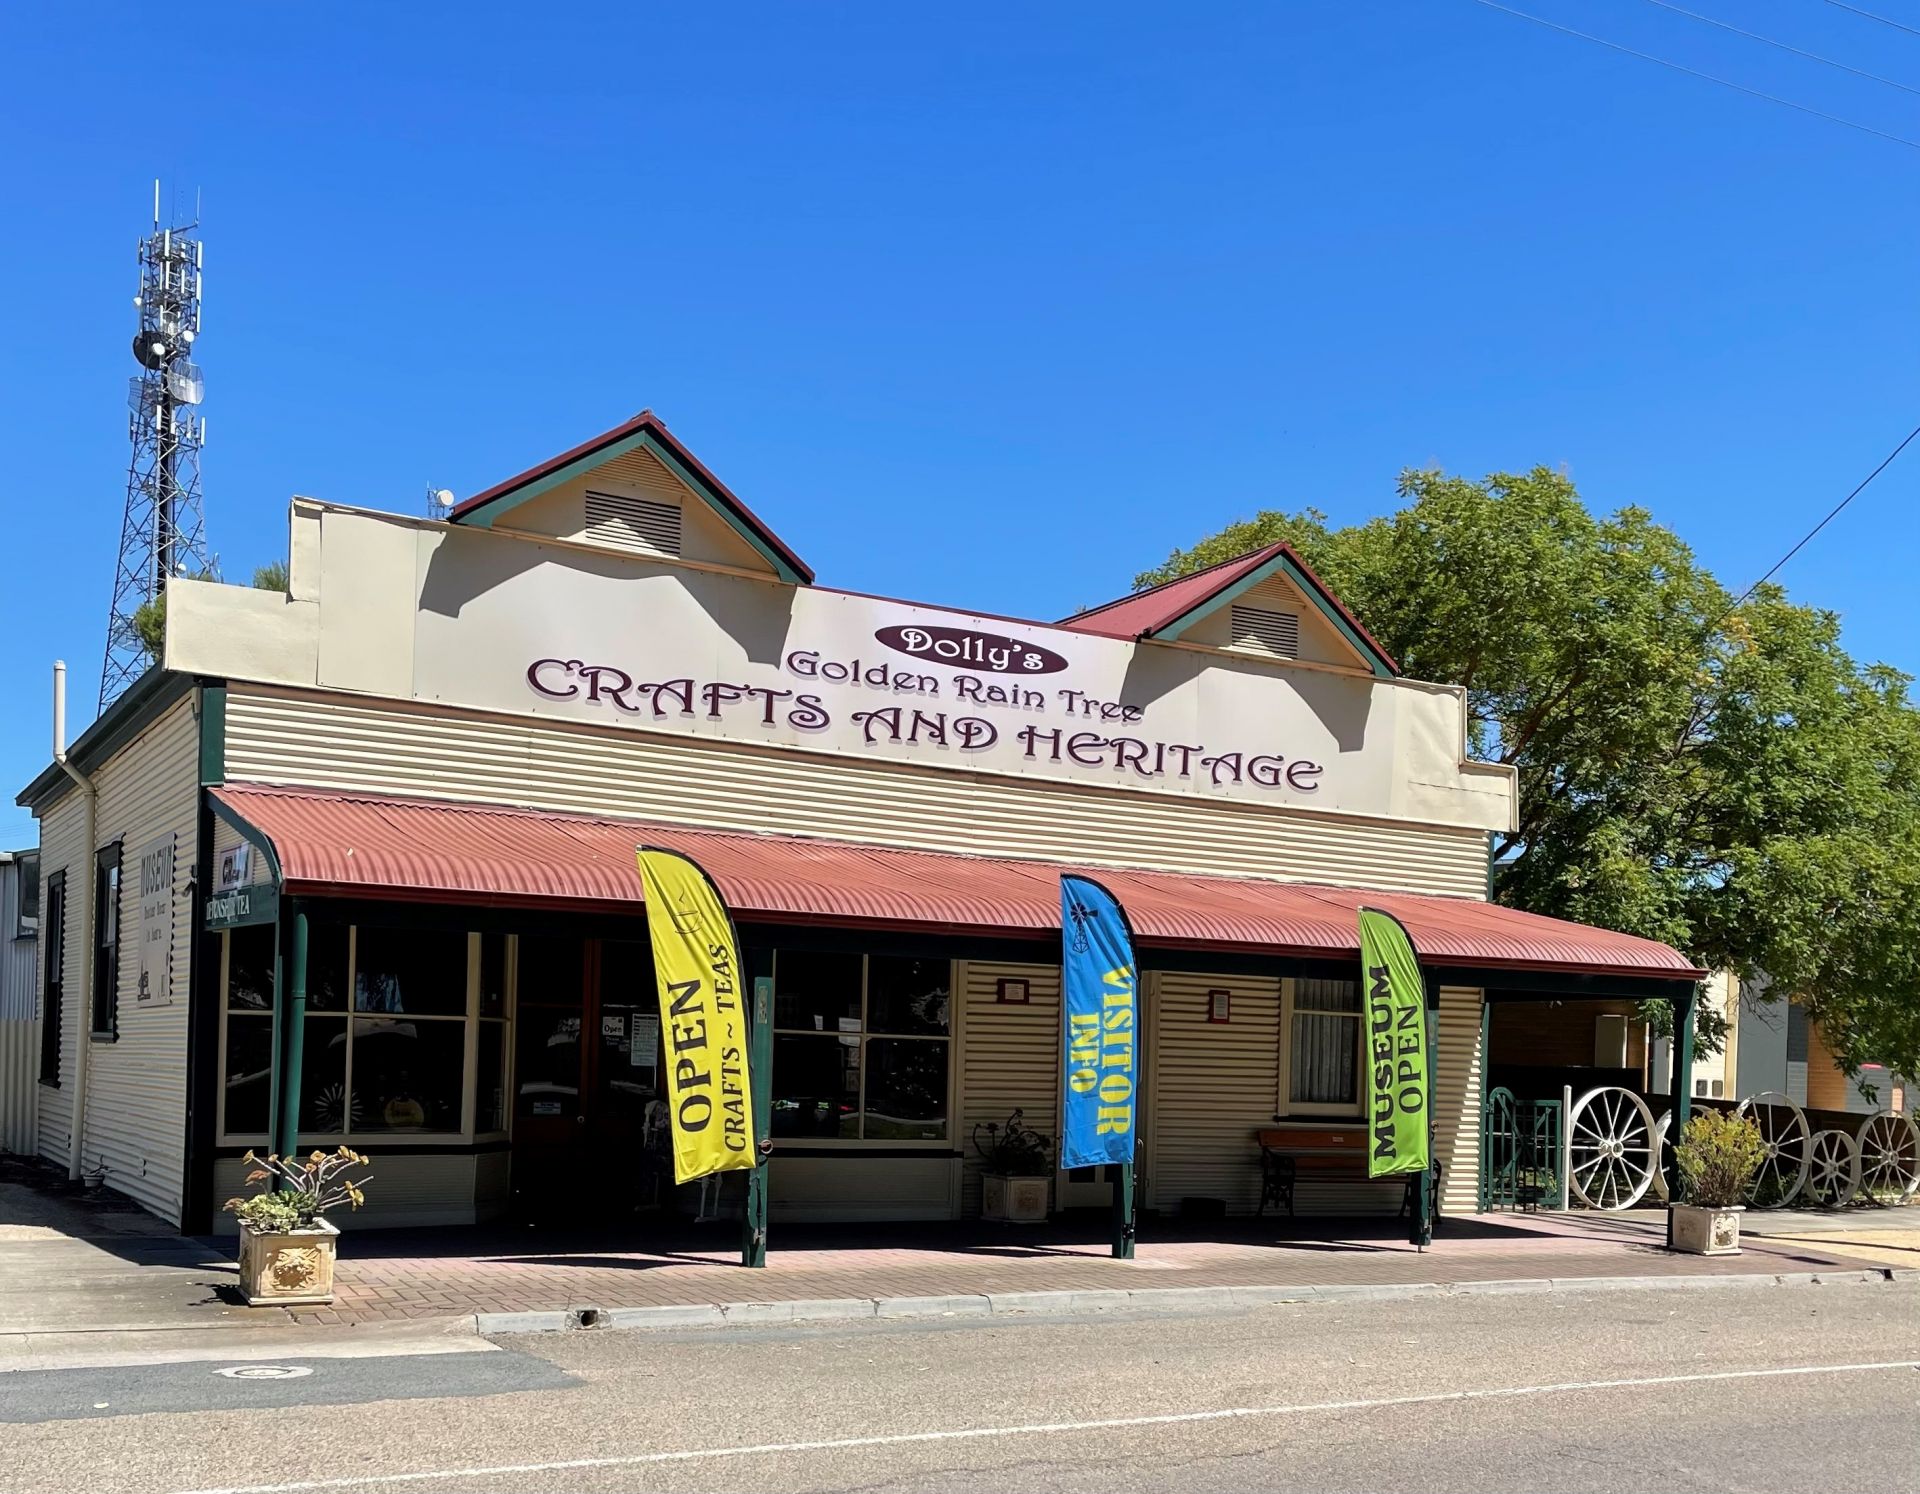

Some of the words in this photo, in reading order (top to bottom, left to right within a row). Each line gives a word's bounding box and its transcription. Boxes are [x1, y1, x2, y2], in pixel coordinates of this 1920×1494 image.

[788, 650, 940, 695] Golden
[954, 675, 1046, 709] Rain
[1058, 689, 1143, 724] Tree
[900, 627, 1045, 673] Dolly's
[527, 658, 831, 730] CRAFTS
[850, 707, 999, 750] AND
[1016, 724, 1326, 793] HERITAGE
[140, 844, 173, 898] MUSEUM
[237, 895, 250, 915] TEA
[708, 943, 735, 1014] TEAS
[666, 979, 712, 1133] OPEN
[1070, 1012, 1100, 1093] INFO
[1096, 964, 1133, 1135] VISITOR
[1369, 963, 1397, 1162] MUSEUM
[1396, 1004, 1424, 1114] OPEN
[721, 1047, 746, 1152] CRAFTS
